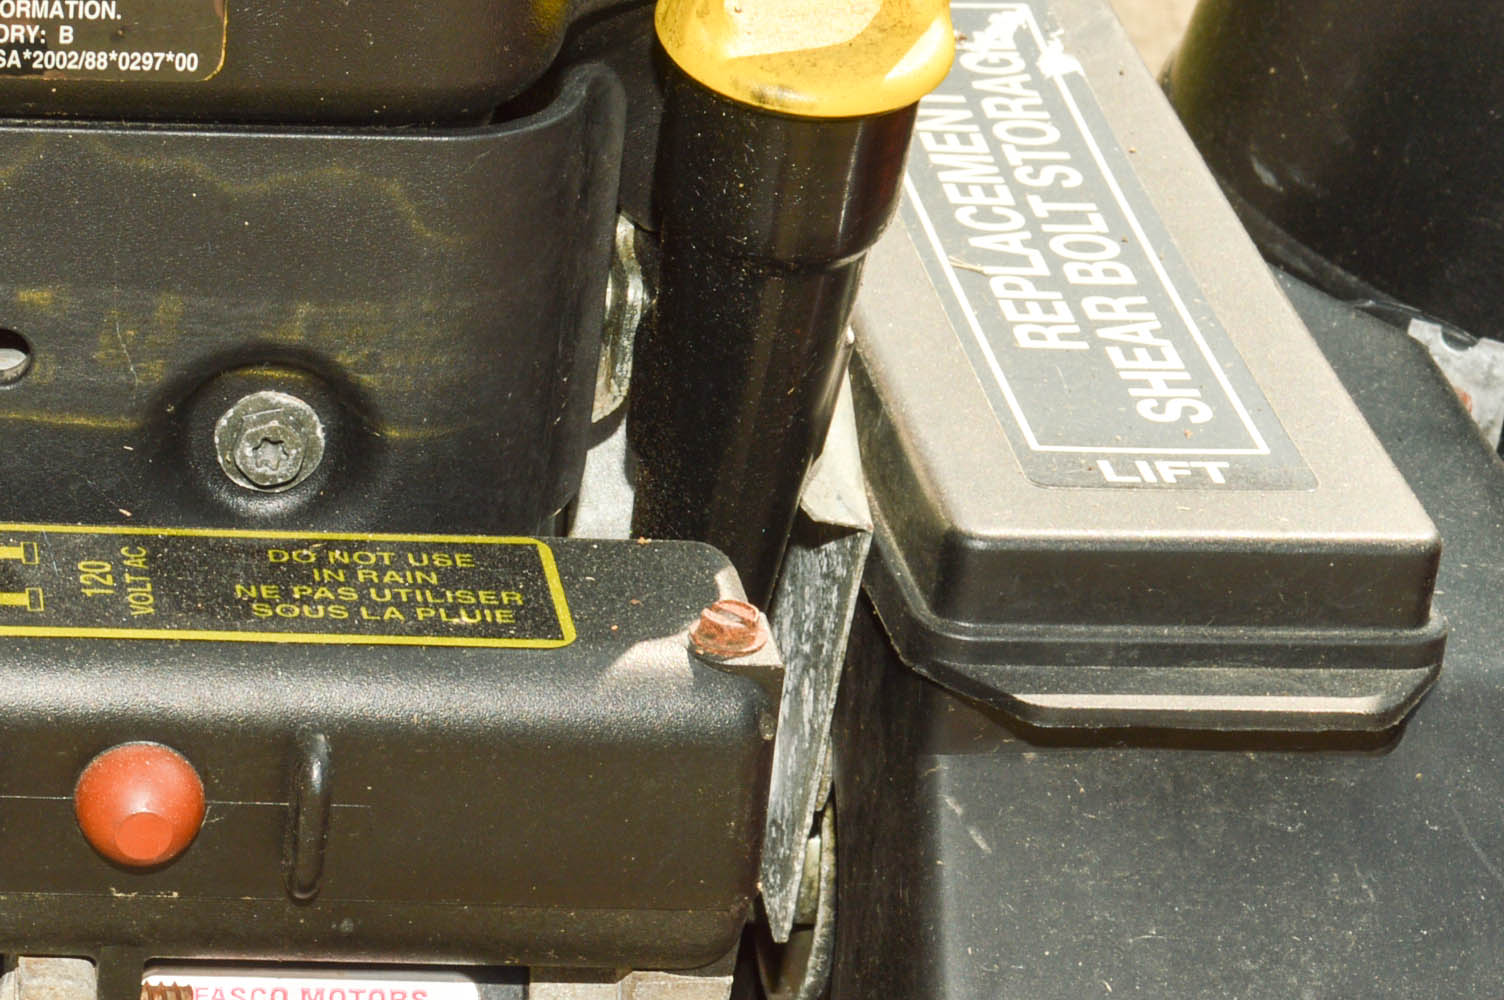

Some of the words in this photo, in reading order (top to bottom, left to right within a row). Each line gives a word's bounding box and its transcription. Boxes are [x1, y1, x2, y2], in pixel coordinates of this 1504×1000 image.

[58, 26, 74, 44] B
[959, 42, 1084, 189] STORAG
[1025, 194, 1138, 285] BOLT
[1081, 295, 1213, 425] SHEAR
[1095, 458, 1229, 484] LIFT
[120, 545, 150, 570] AC
[267, 549, 317, 564] DO
[328, 551, 395, 566] NOT
[407, 553, 476, 568] USE
[77, 560, 115, 597] 120
[313, 568, 346, 583] IN
[357, 570, 439, 585] RAIN
[124, 572, 154, 617] VOLT
[235, 583, 279, 600] NE
[292, 586, 360, 602] PAS
[369, 588, 524, 606] UTILISER
[252, 603, 349, 620] SOUS
[360, 606, 405, 621] LA
[415, 609, 516, 624] PLUIE
